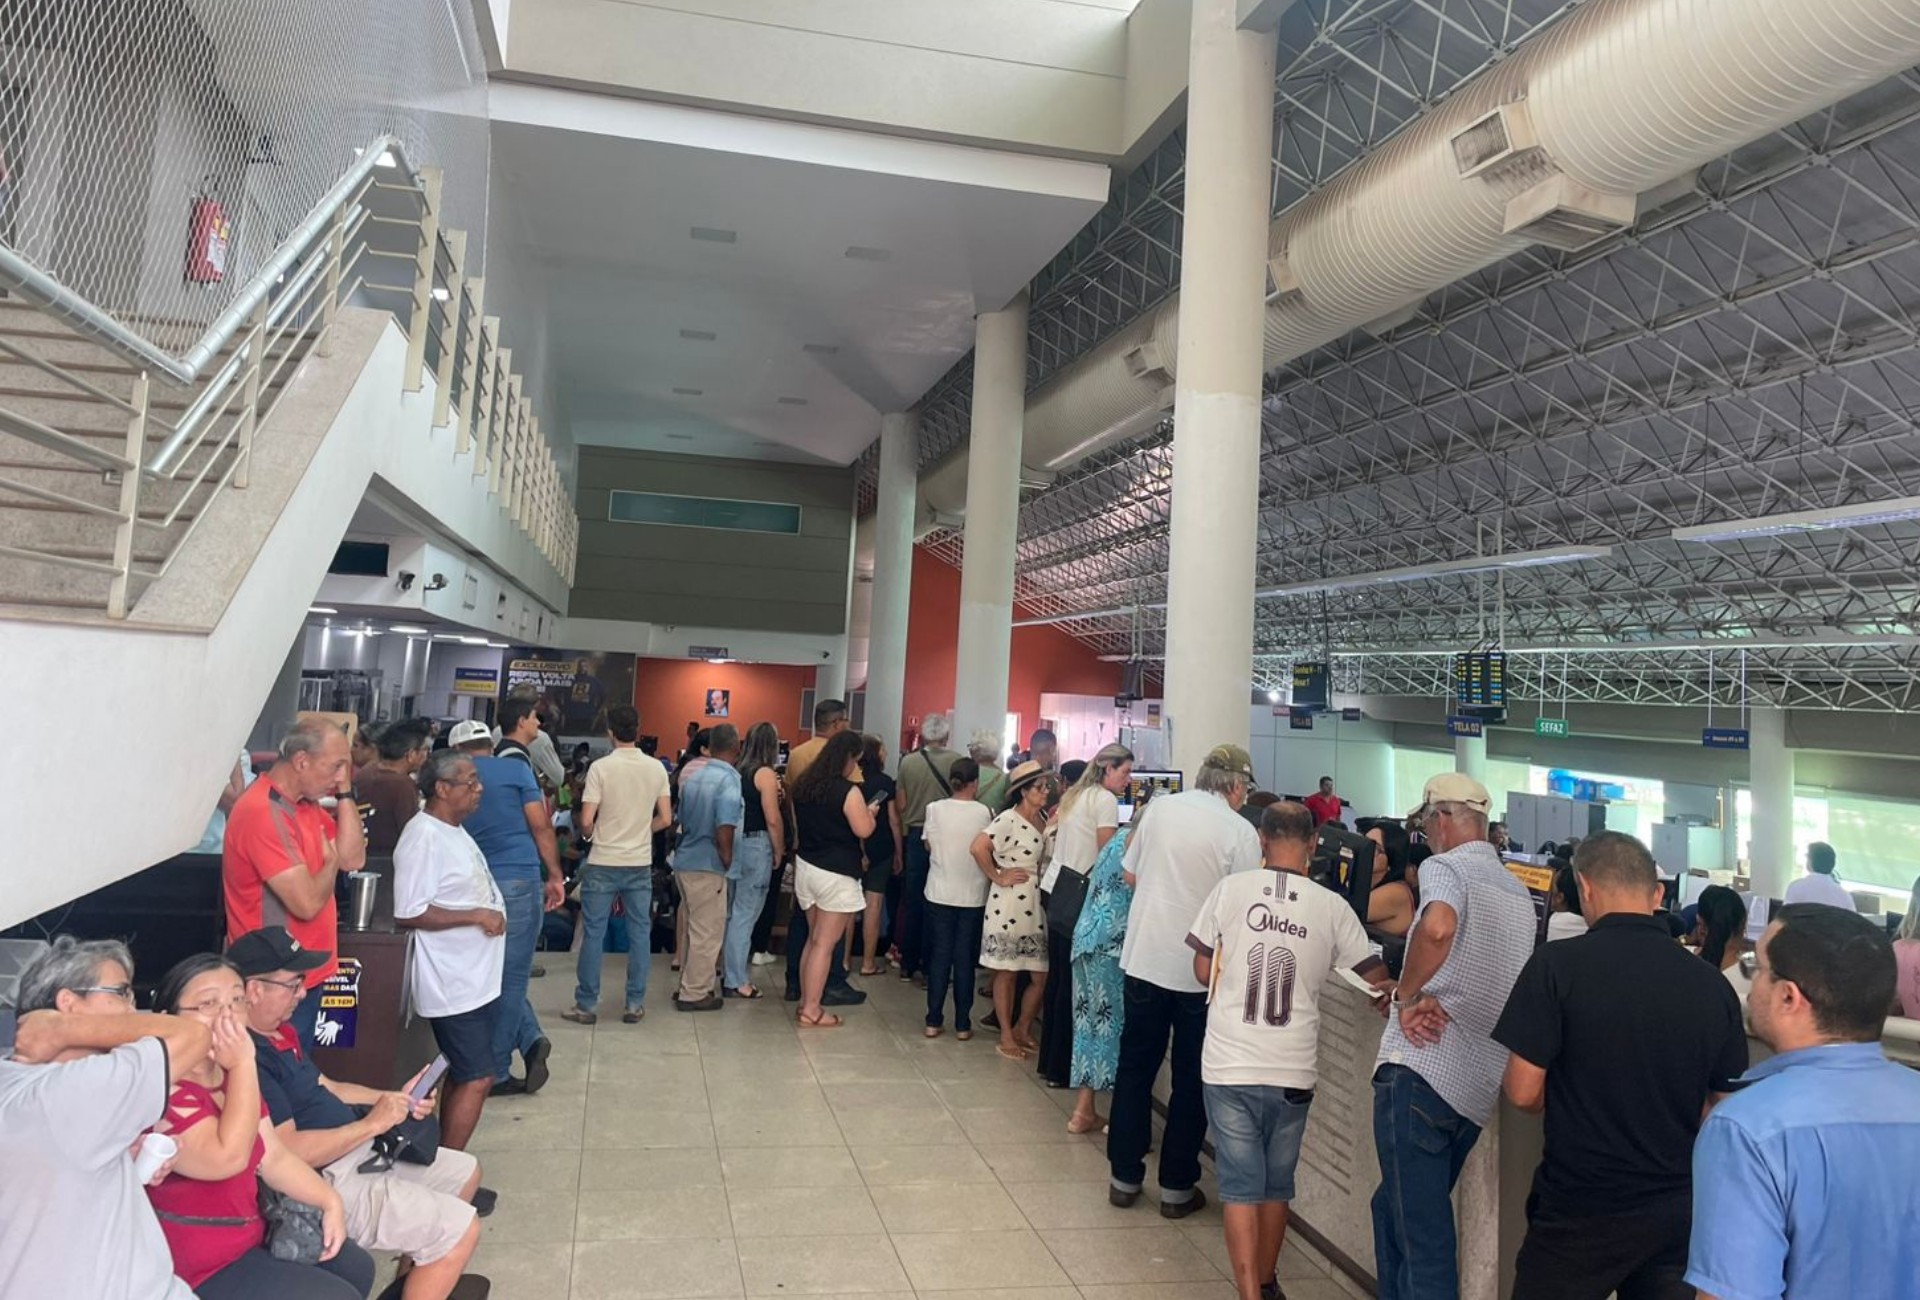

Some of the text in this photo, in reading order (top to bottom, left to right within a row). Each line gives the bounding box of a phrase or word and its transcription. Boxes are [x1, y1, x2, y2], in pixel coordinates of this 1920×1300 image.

[508, 670, 576, 680] REFIS VOLTA
[544, 679, 573, 687] MAIS
[1453, 721, 1480, 733] TELA 02
[1540, 722, 1564, 734] SEFAZ
[1246, 902, 1308, 939] Midea
[1242, 942, 1297, 1027] 10
